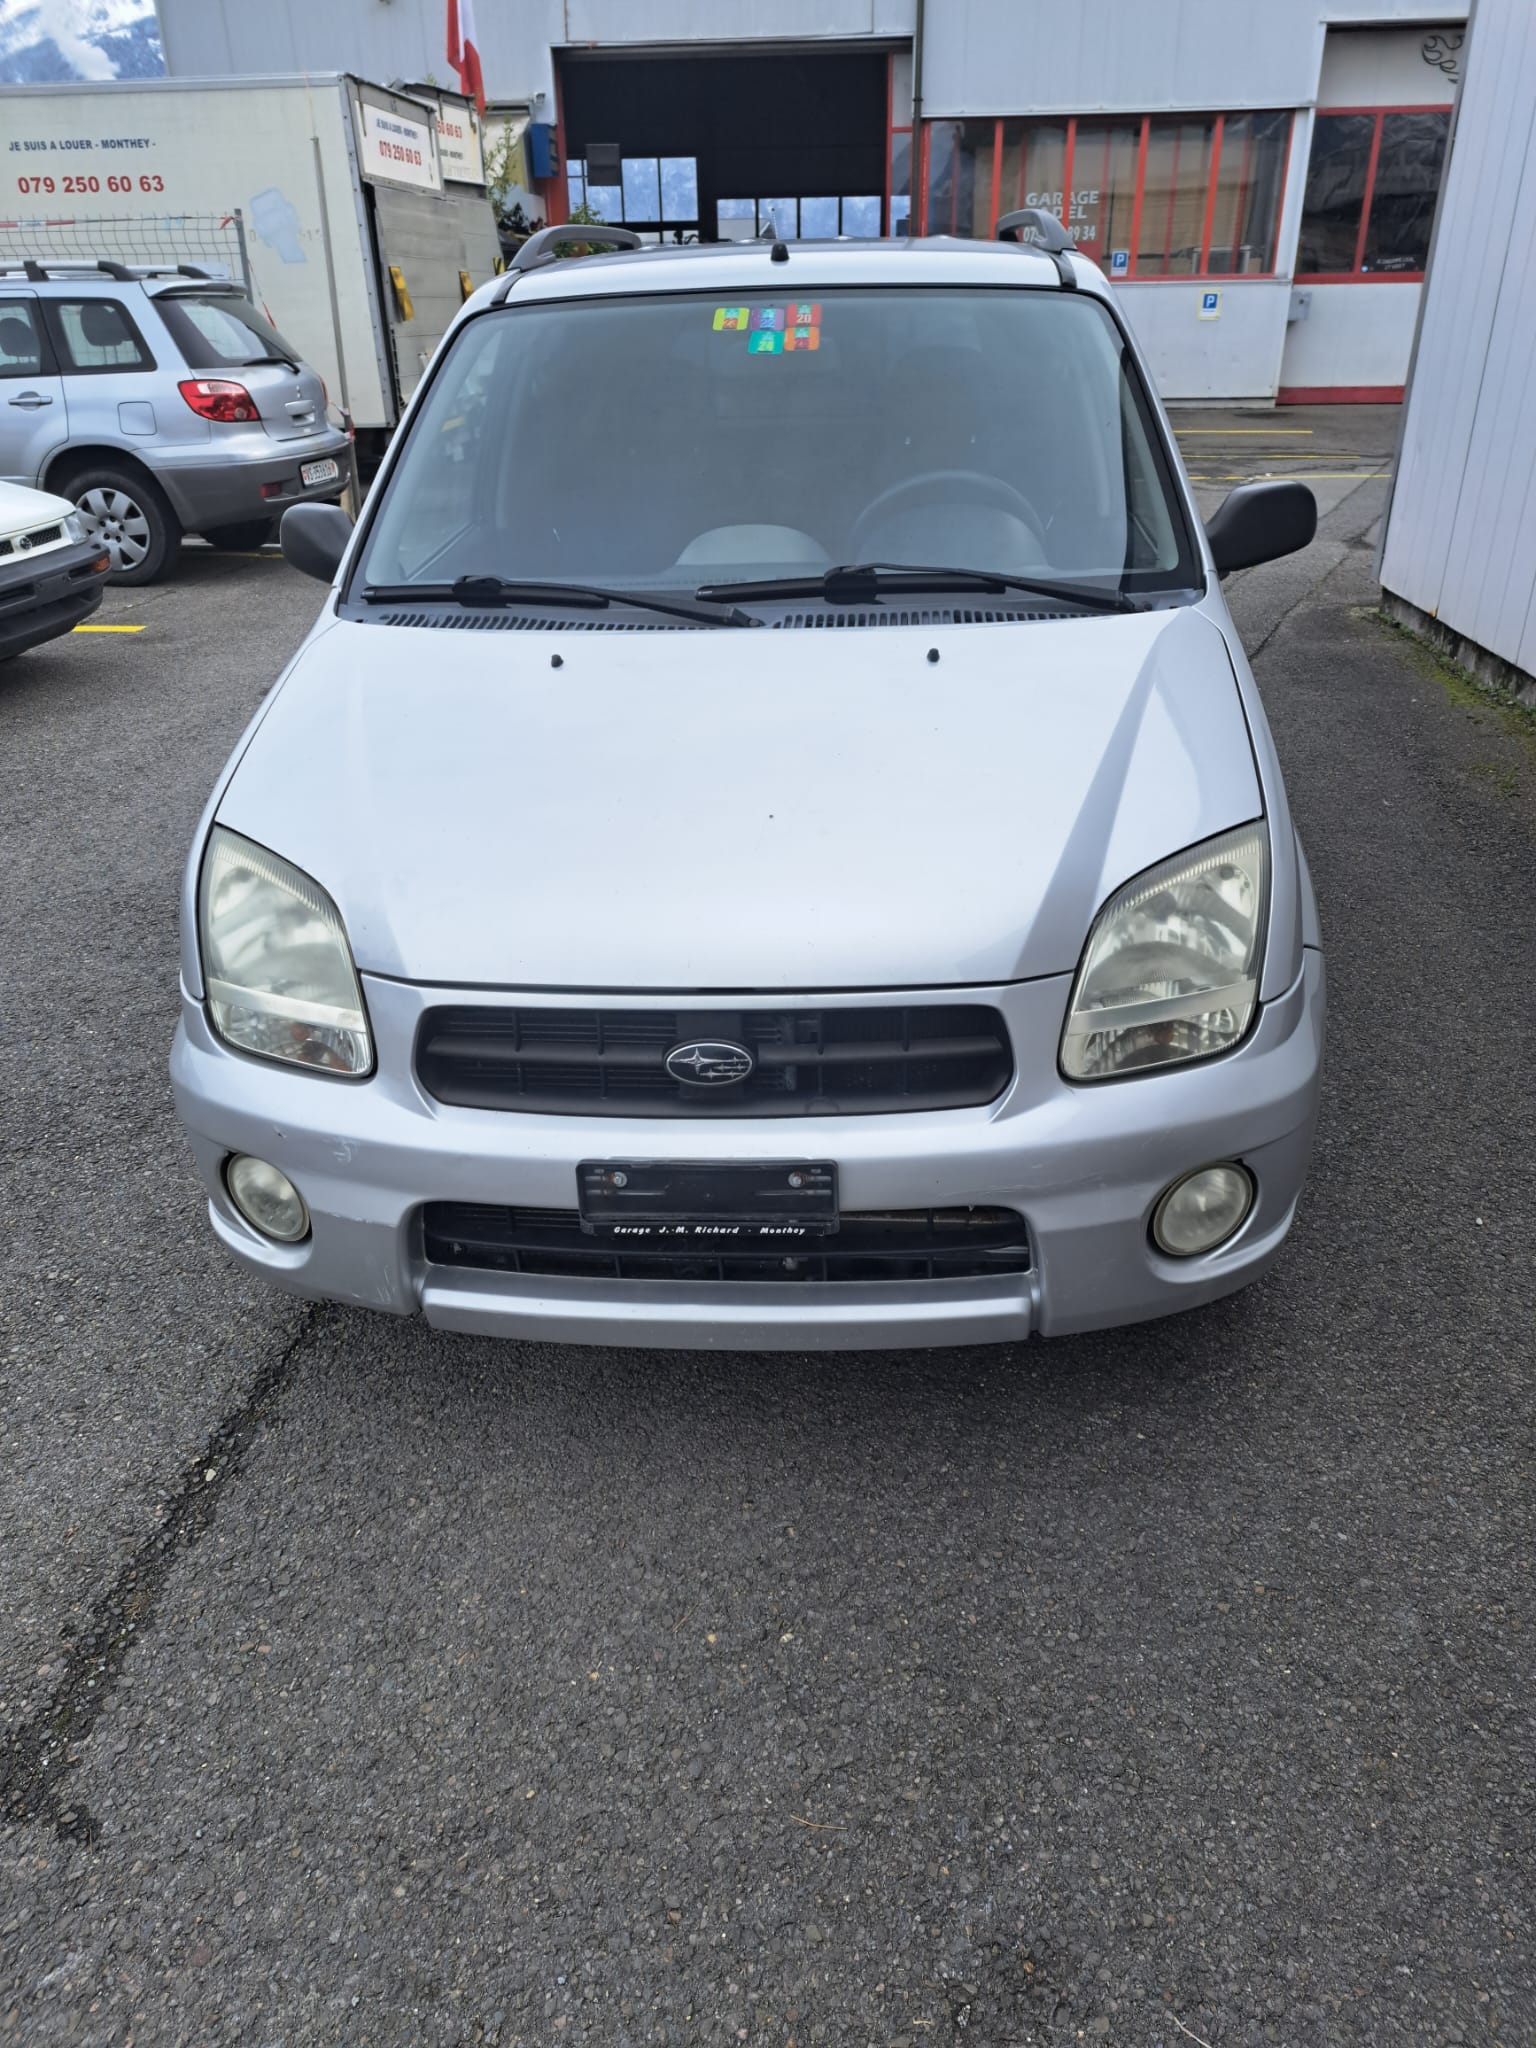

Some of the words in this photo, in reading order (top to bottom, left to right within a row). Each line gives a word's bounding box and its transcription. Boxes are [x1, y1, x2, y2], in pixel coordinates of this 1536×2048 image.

[437, 120, 446, 135] 50
[9, 141, 21, 151] JE
[24, 141, 47, 151] SUIS
[50, 141, 57, 150] A
[59, 140, 93, 150] LOUER
[101, 139, 150, 149] MONTHEY
[18, 176, 55, 194] 079
[62, 176, 100, 193] 250
[107, 175, 132, 193] 60
[139, 175, 164, 193] 63
[1082, 225, 1096, 241] 34
[760, 318, 775, 329] 22
[796, 314, 812, 324] 20
[614, 1226, 651, 1235] Garage
[695, 1226, 740, 1234] Richard
[760, 1226, 805, 1235] Monthey
